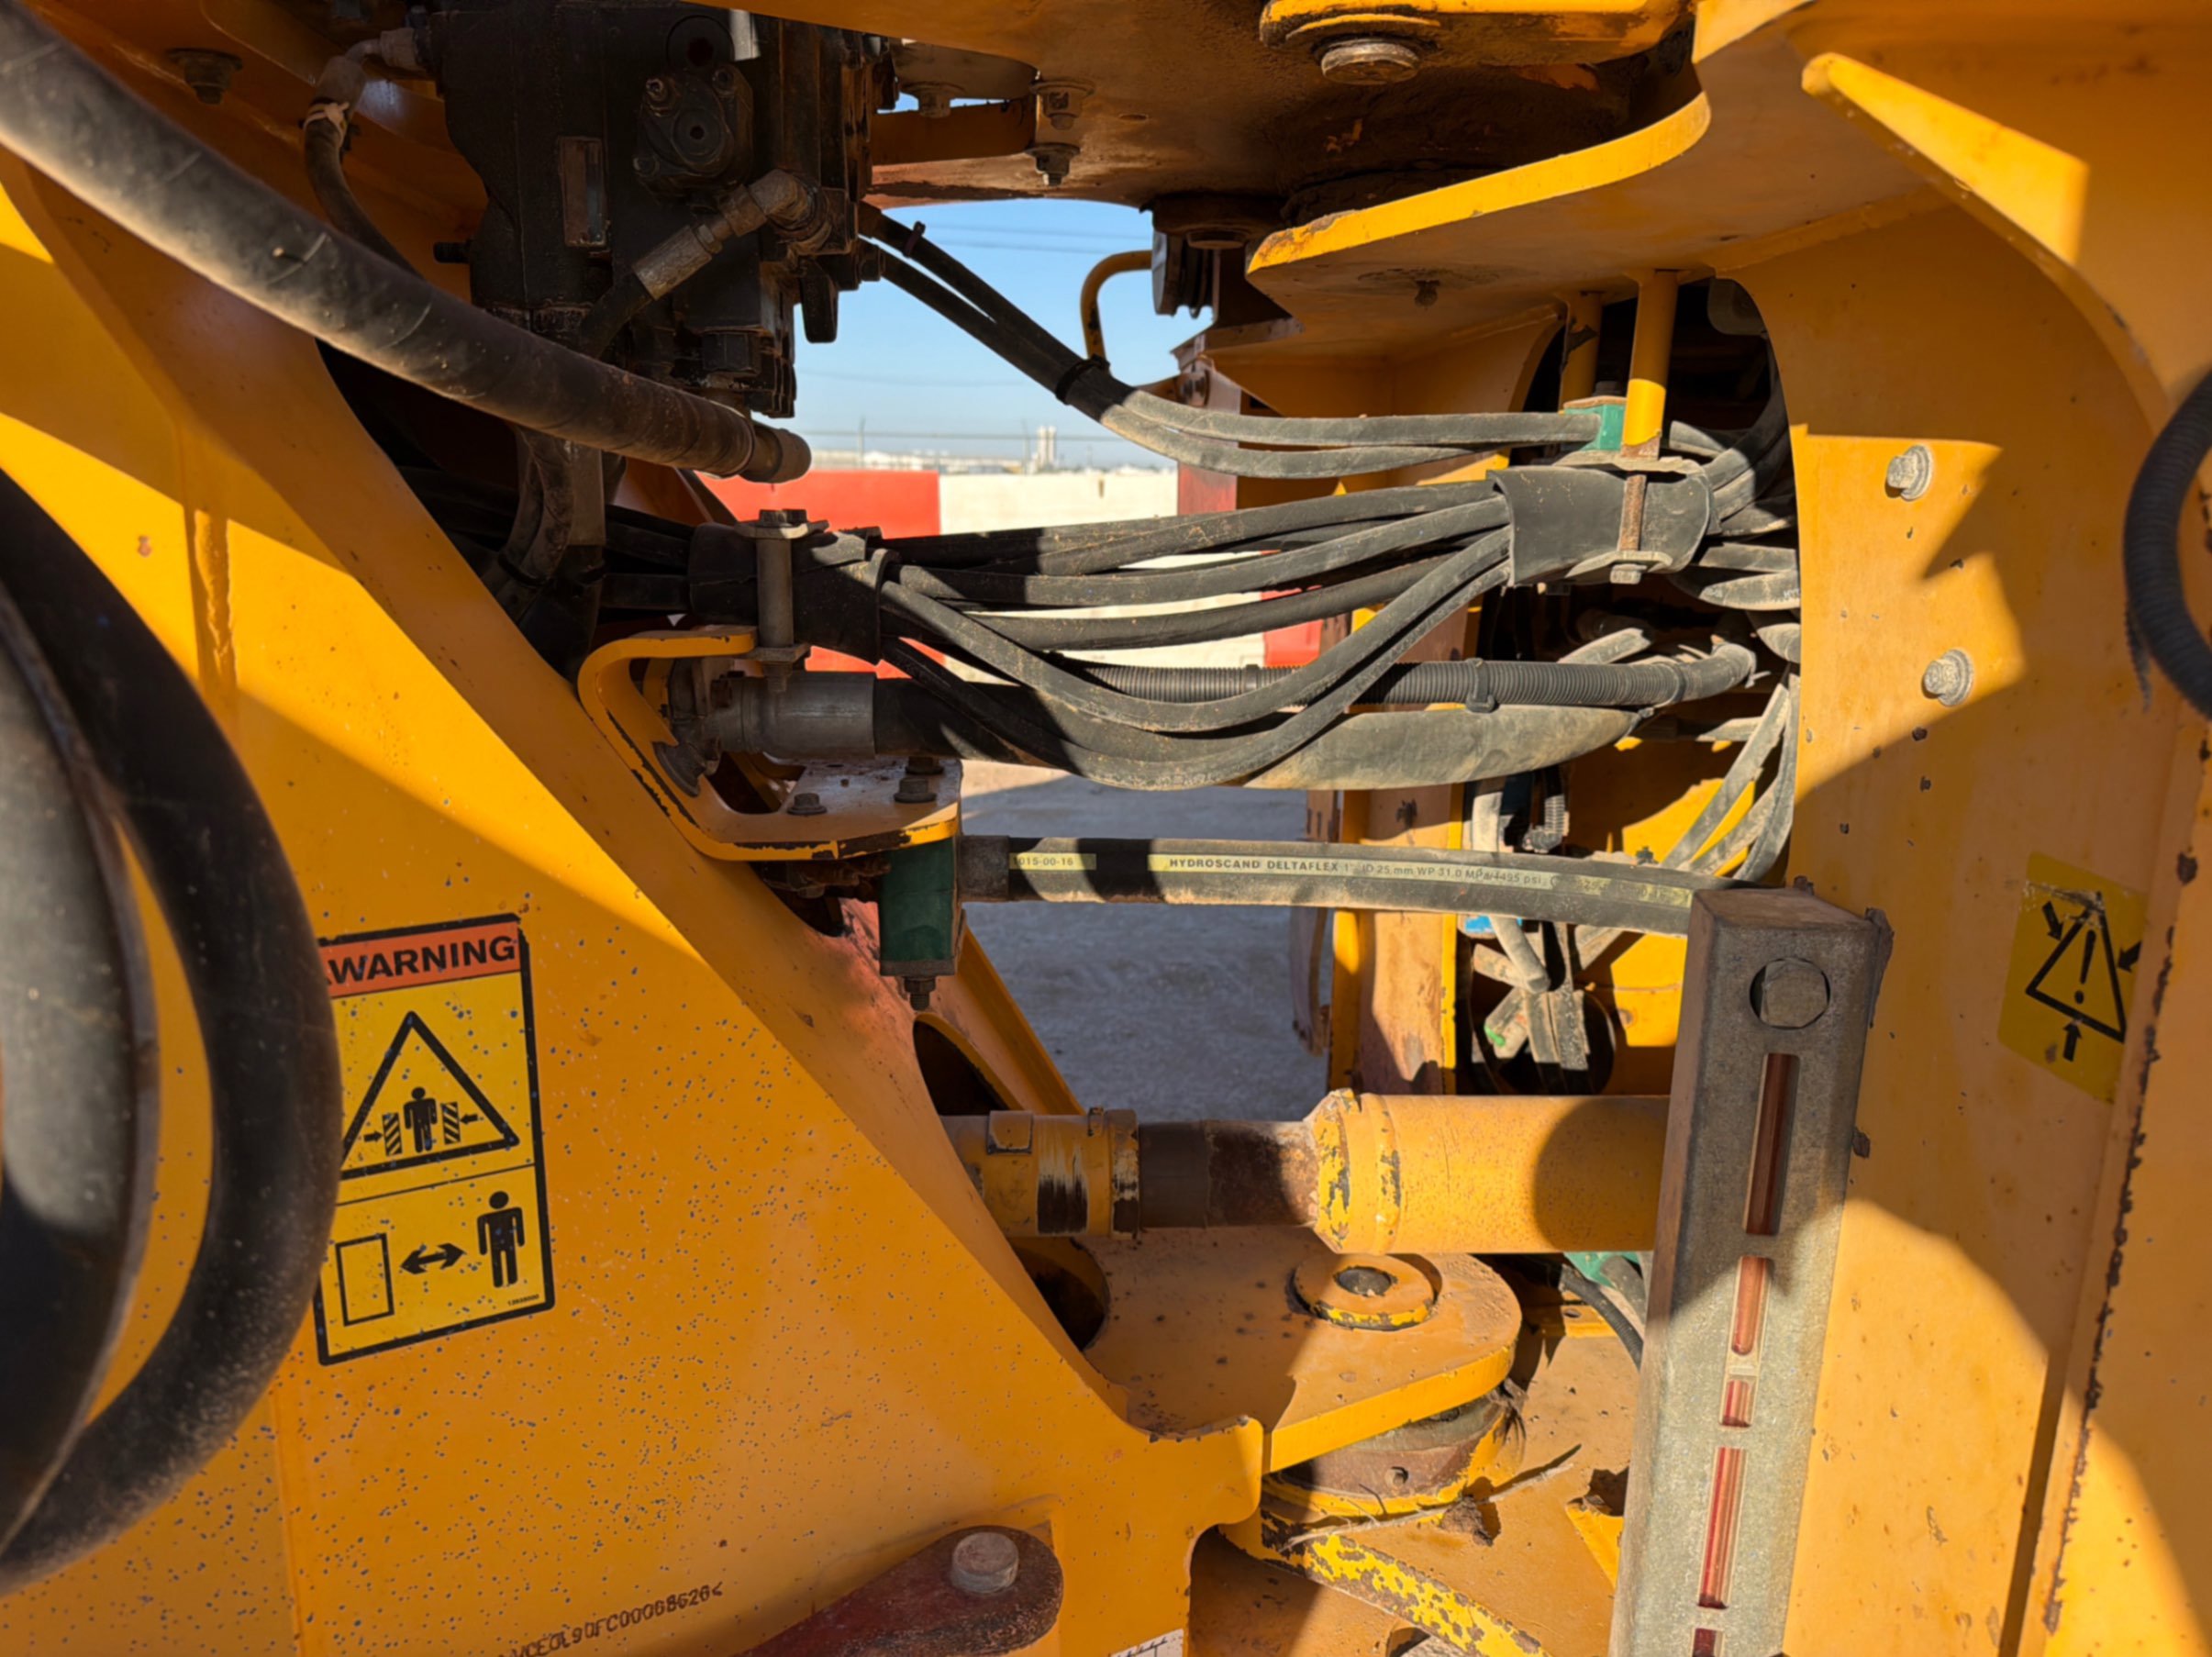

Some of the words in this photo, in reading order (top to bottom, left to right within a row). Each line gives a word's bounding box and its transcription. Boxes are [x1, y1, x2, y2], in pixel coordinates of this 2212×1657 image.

[1169, 858, 1261, 869] HYDROSCAND
[1267, 860, 1339, 872] DELTAFLEX
[1394, 866, 1414, 875] mm
[1417, 866, 1435, 876] WP
[1438, 868, 1462, 878] 31.0
[1523, 875, 1542, 884] psi
[328, 935, 516, 985] WARNING
